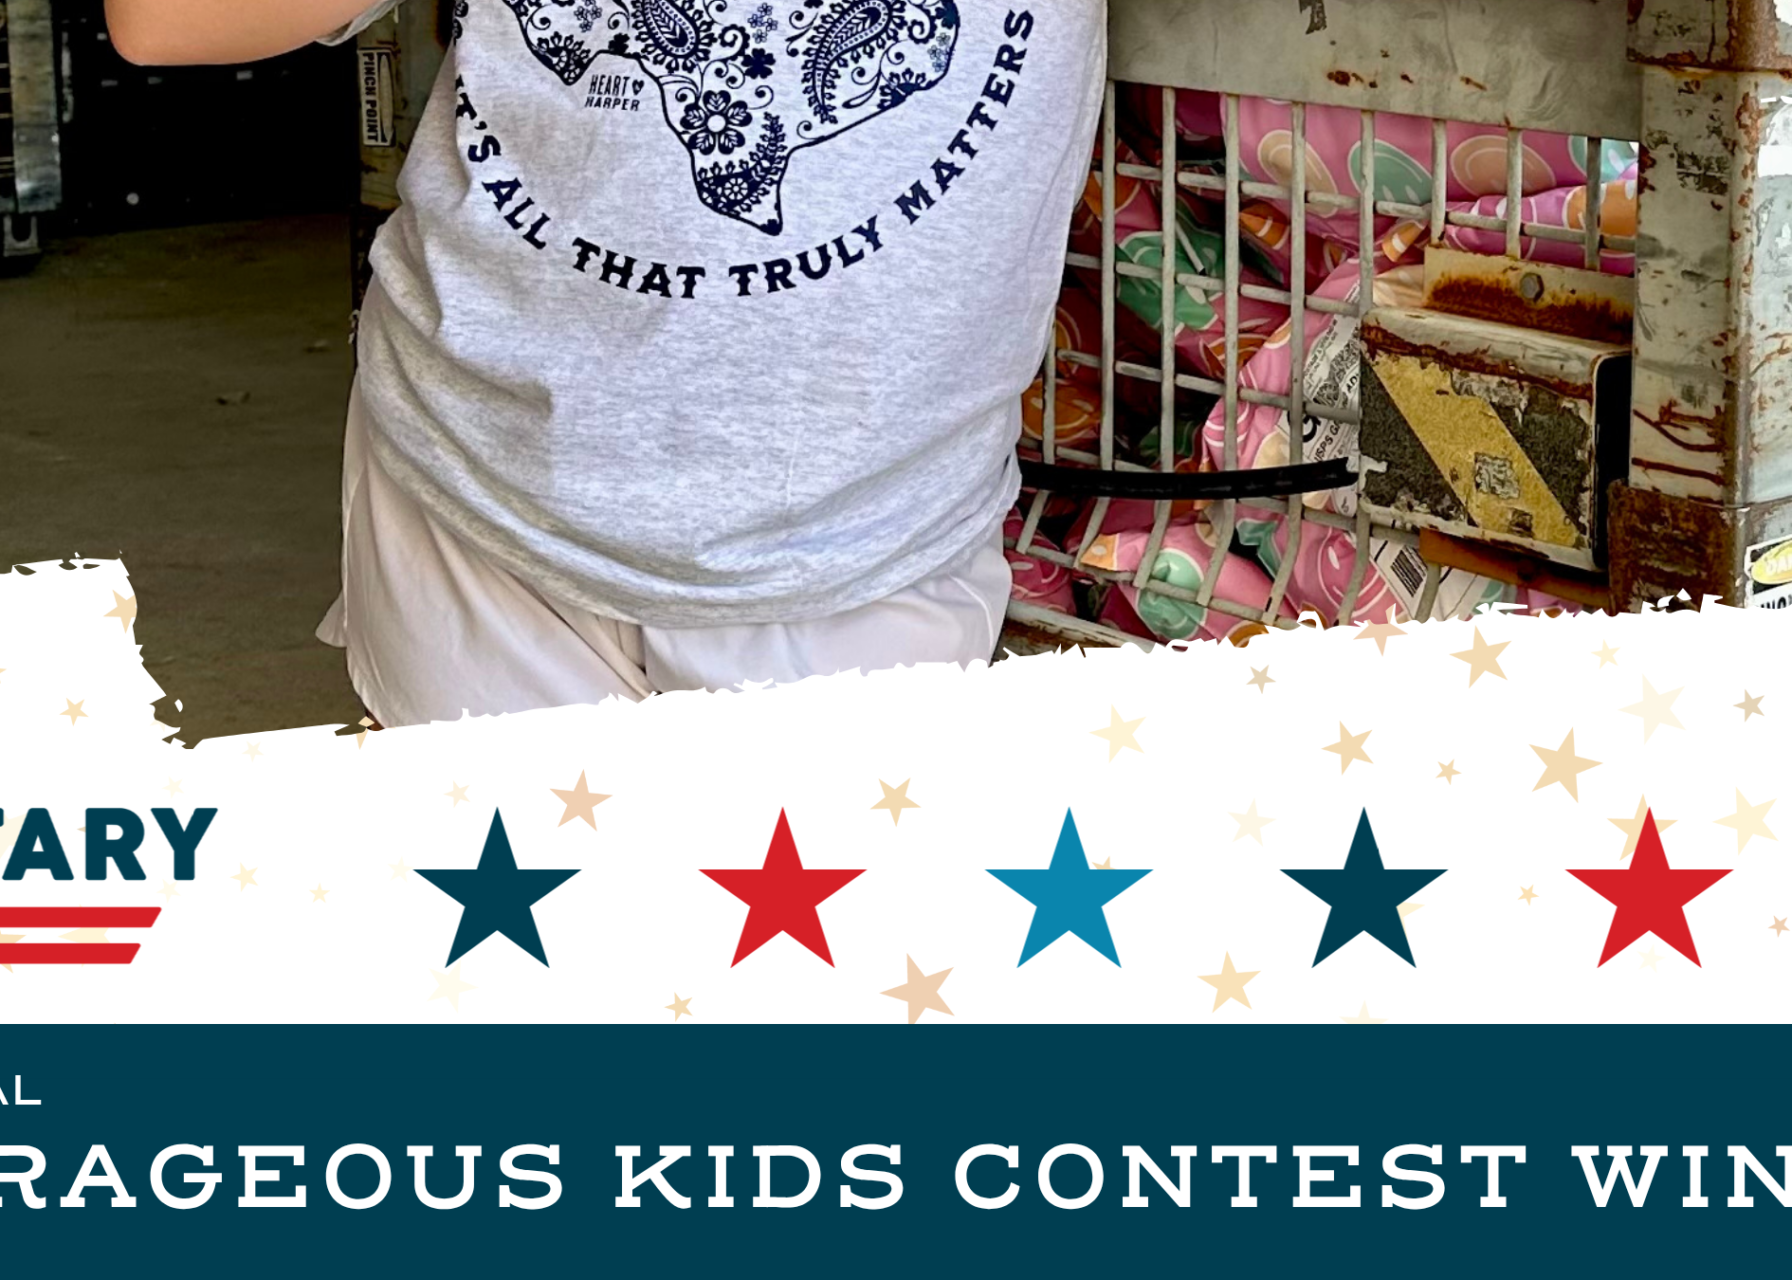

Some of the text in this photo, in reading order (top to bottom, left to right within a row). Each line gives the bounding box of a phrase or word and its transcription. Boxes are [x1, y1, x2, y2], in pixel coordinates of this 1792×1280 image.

[362, 52, 379, 142] PINCH POINT
[584, 96, 641, 112] HARPER
[588, 73, 631, 97] HEART
[481, 177, 551, 250] ALL
[572, 237, 706, 299] THAT
[729, 214, 884, 297] TRULY
[893, 8, 1035, 226] MATTERS
